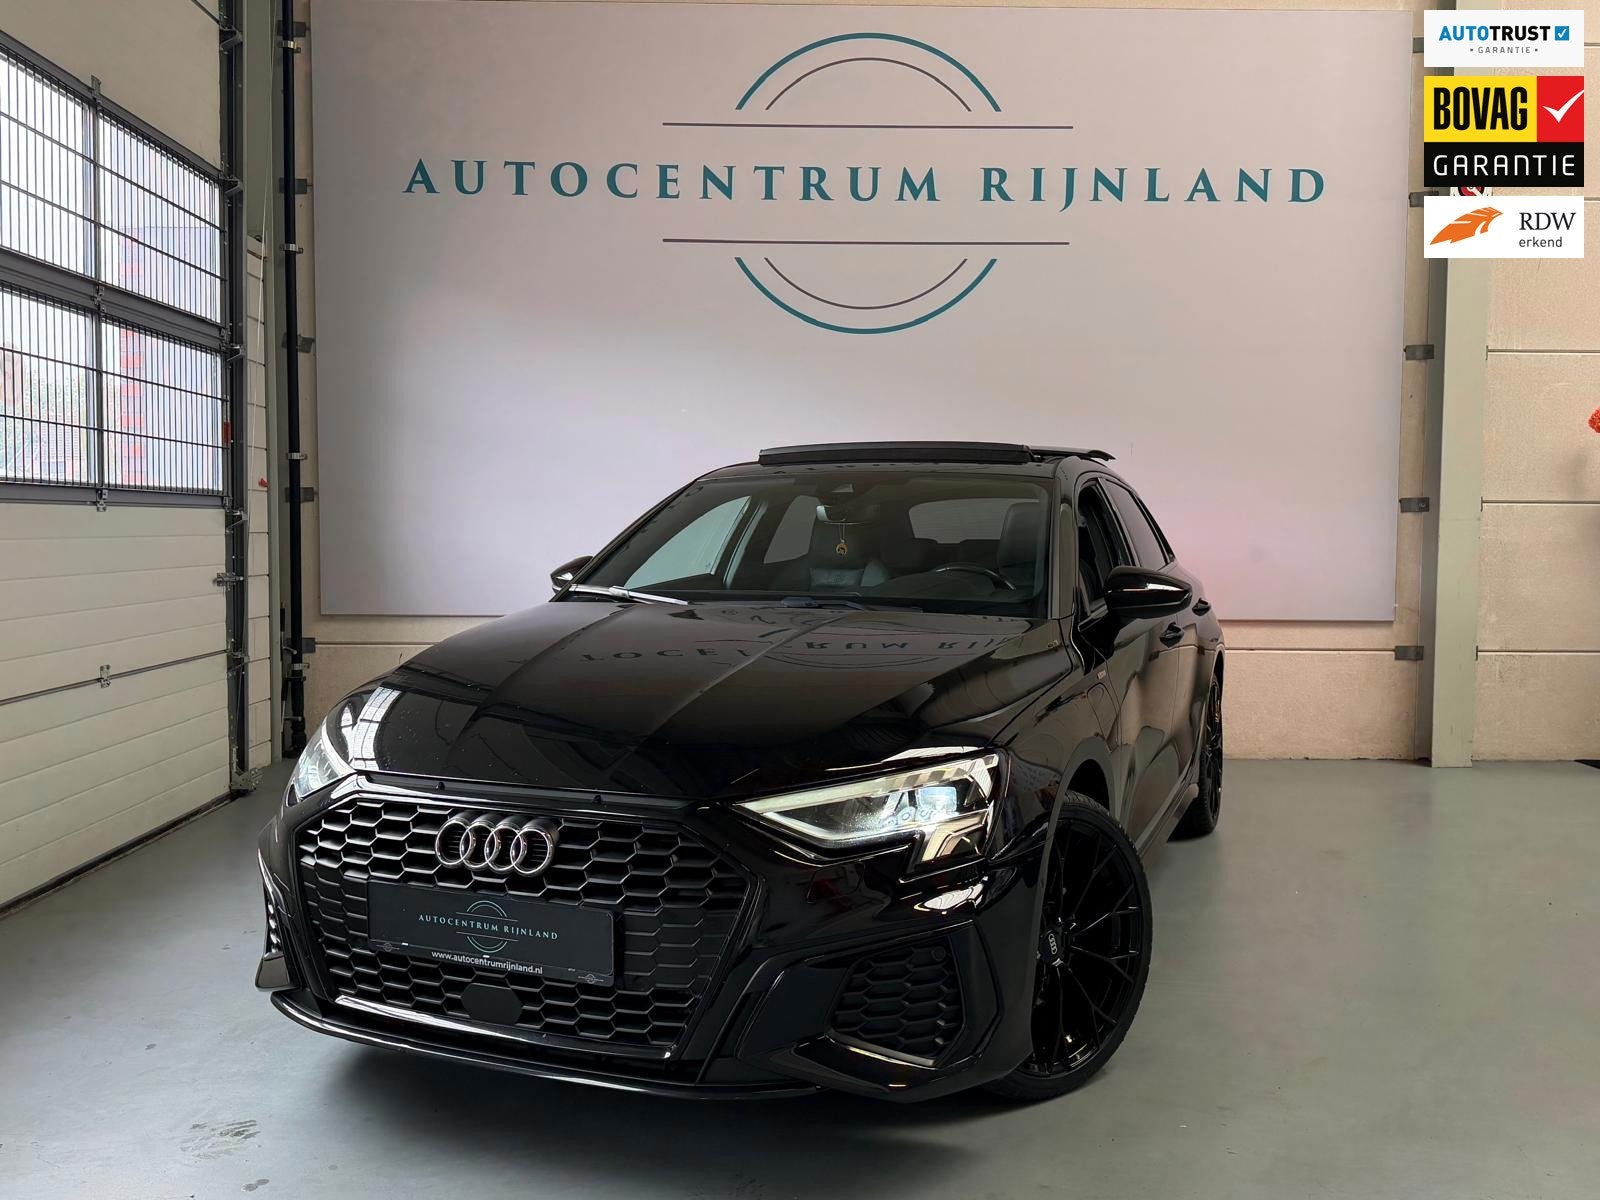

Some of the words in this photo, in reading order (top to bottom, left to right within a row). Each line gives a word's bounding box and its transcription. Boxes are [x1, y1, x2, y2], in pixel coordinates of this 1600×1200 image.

[402, 158, 941, 202] AUTOCENTRUM
[979, 167, 1325, 213] RIJNLAND
[419, 914, 498, 931] AUTOCENTRUM
[503, 925, 558, 940] RIJNLAND
[431, 951, 543, 974] www.autocentrumrijnland.nl
